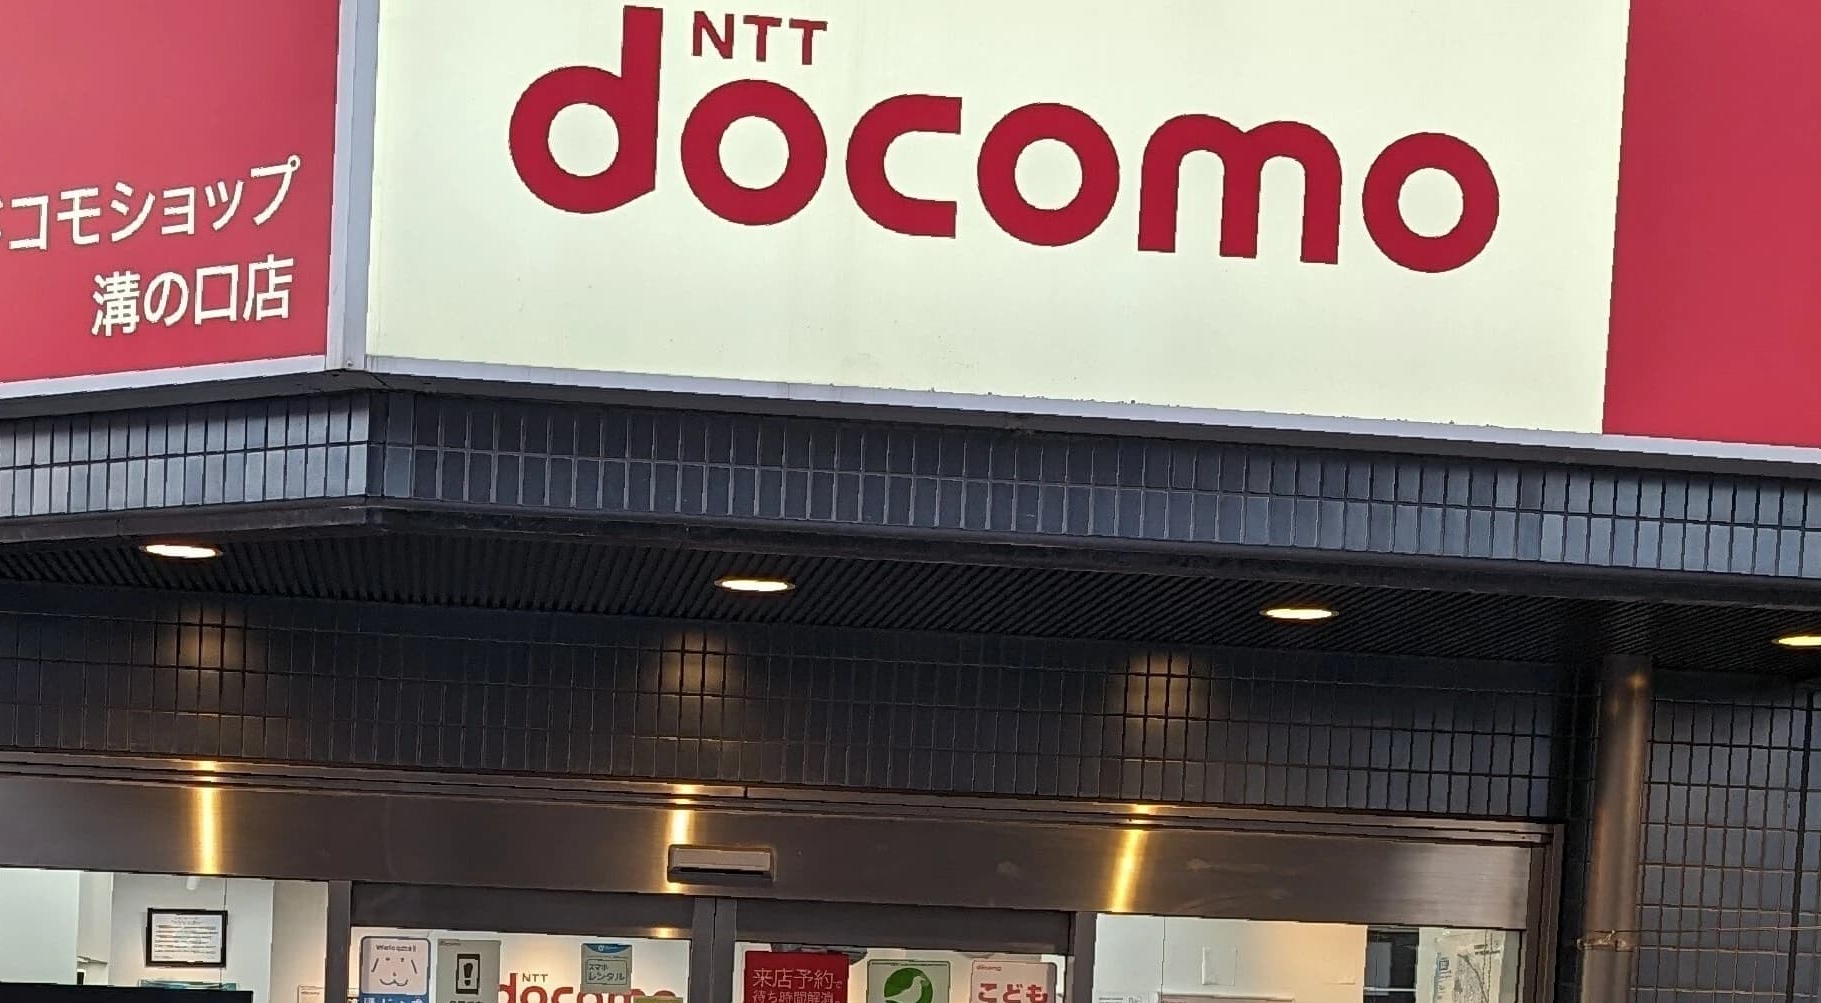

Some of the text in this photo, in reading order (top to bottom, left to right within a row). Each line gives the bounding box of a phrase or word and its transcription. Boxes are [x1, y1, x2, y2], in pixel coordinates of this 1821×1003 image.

[691, 10, 828, 66] NTT
[508, 5, 1499, 273] docomo
[91, 254, 294, 336] 溝の口店
[523, 973, 548, 983] NTT
[588, 972, 625, 981] レンタル
[753, 968, 842, 989] 来店予約で
